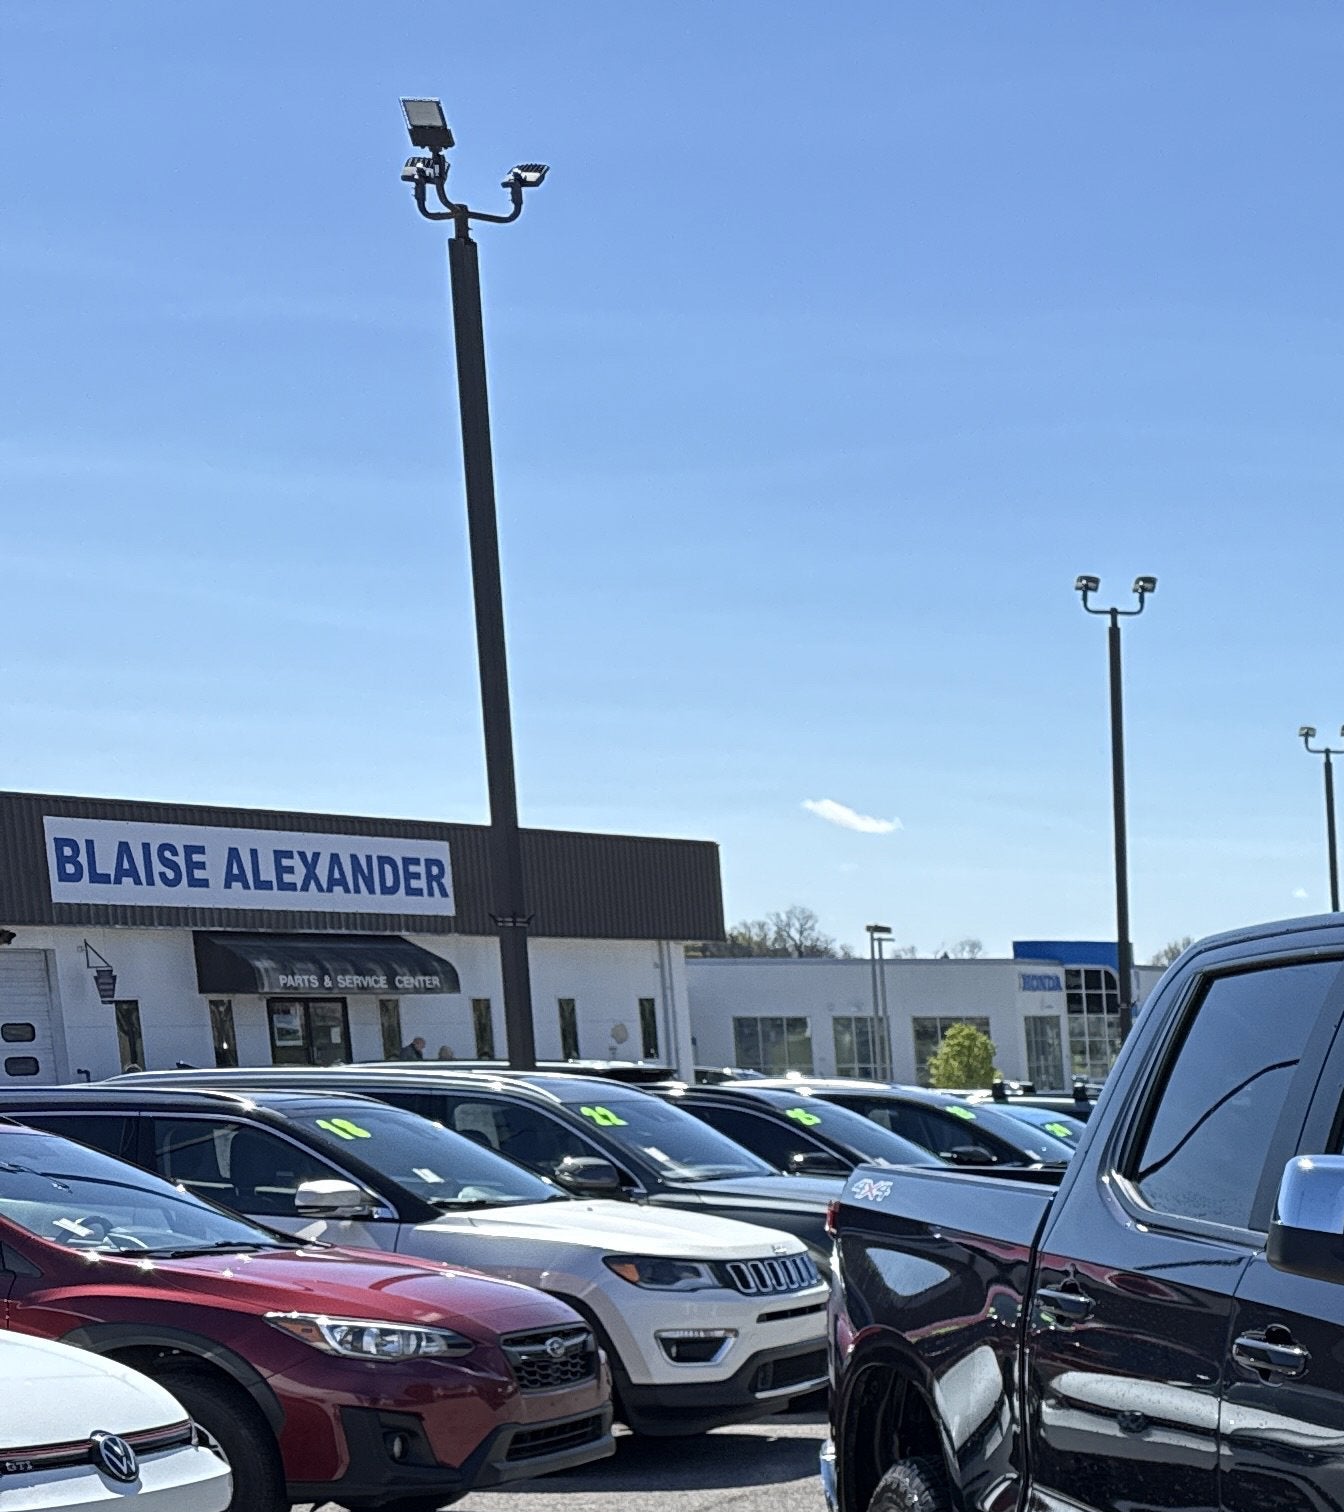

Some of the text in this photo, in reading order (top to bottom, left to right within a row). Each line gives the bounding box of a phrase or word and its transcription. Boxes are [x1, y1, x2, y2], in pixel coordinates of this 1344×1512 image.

[53, 836, 451, 899] BLAISE ALEXANDER
[278, 974, 442, 990] PARTS & SERVICE CENTER
[5, 1460, 33, 1472] GTI
